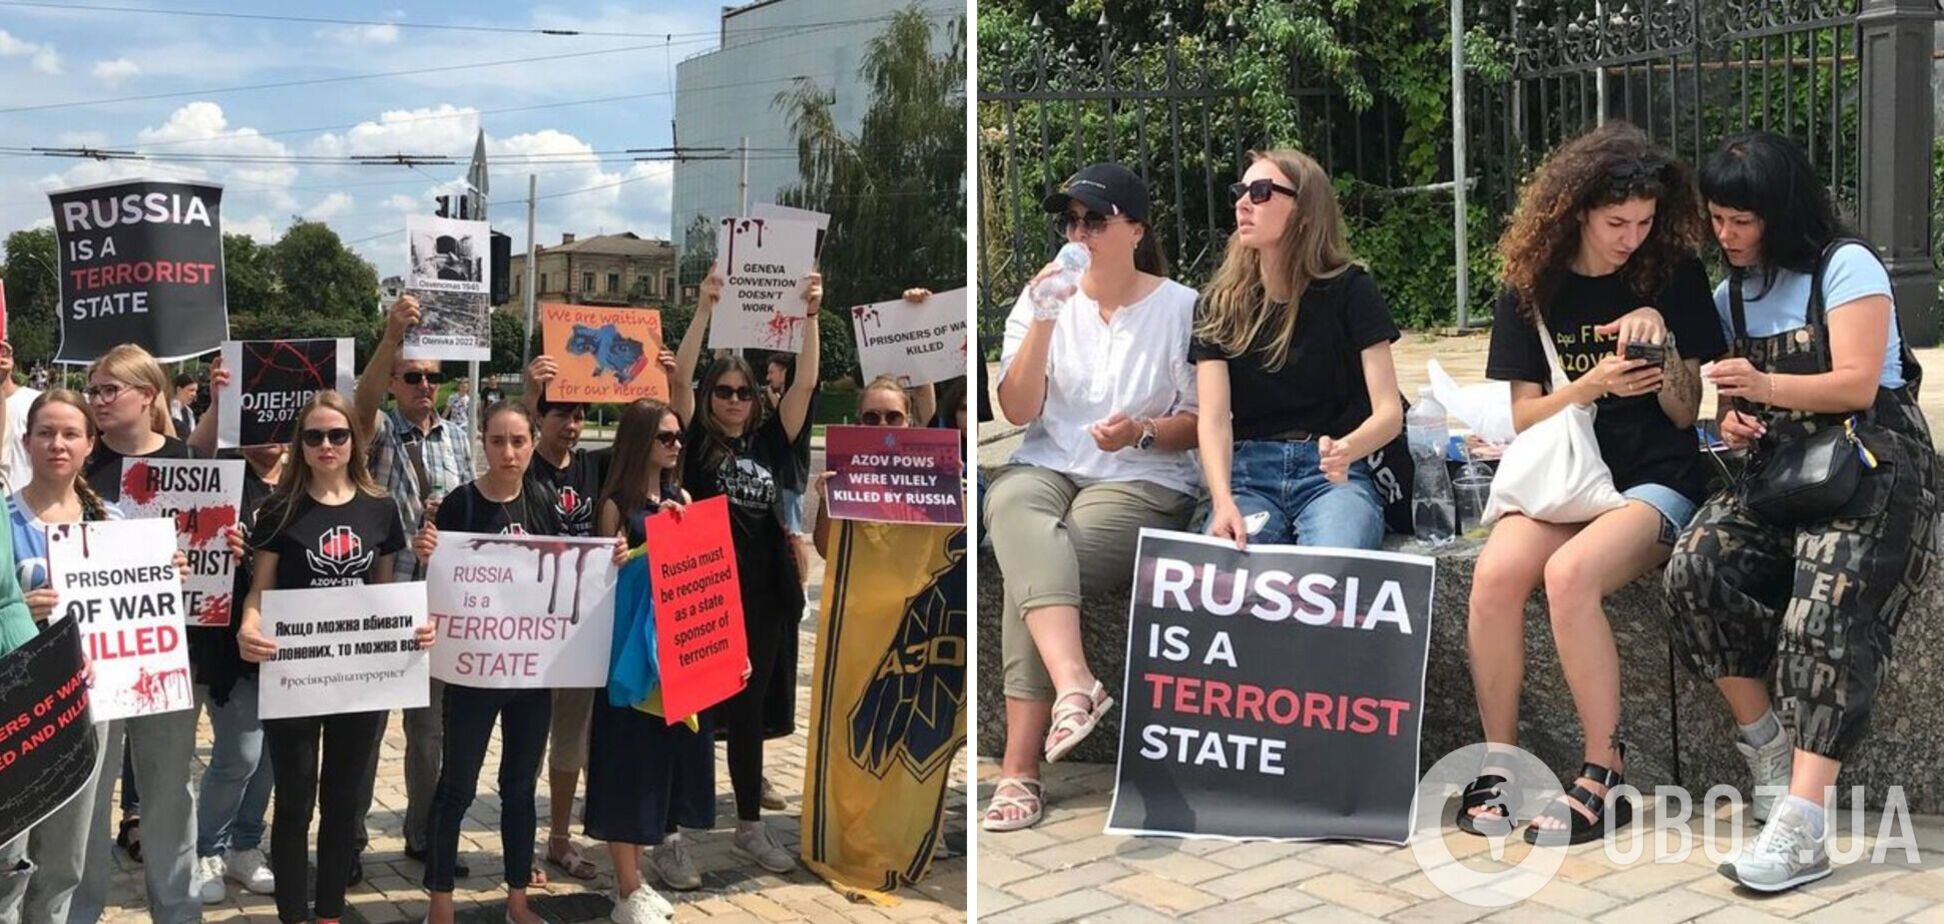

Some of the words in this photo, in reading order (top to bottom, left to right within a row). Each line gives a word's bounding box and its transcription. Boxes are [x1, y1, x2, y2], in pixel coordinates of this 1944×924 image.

[63, 192, 212, 232] RUSSIA
[70, 240, 93, 261] IS
[101, 237, 116, 257] A
[70, 261, 215, 290] TERRORIST
[743, 263, 785, 274] GENEVA
[729, 276, 796, 287] CONVENTION
[73, 292, 148, 320] STATE
[738, 290, 784, 299] DOESN'T
[547, 309, 571, 321] We
[575, 312, 598, 323] are
[601, 310, 658, 328] waiting
[742, 303, 775, 312] WORK
[869, 329, 931, 347] PRISONERS
[933, 325, 948, 337] OF
[906, 341, 944, 355] KILLED
[557, 379, 579, 399] for
[584, 384, 609, 394] our
[612, 382, 658, 396] heroes
[851, 454, 890, 466] AZOV
[893, 456, 935, 468] POWS
[145, 466, 221, 493] RUSSIA
[849, 473, 887, 485] WERE
[891, 474, 938, 487] VILELY
[833, 490, 881, 503] KILLED
[884, 492, 902, 503] BY
[906, 494, 957, 506] RUSSIA
[453, 566, 513, 583] RUSSIA
[661, 554, 697, 579] Russia
[698, 546, 724, 568] must
[65, 564, 175, 589] PRISONERS
[660, 587, 675, 604] be
[676, 566, 732, 597] recognized
[66, 600, 101, 624] OF
[110, 592, 176, 621] WAR
[463, 592, 477, 608] is
[481, 595, 490, 608] a
[674, 607, 688, 622] as
[689, 605, 697, 618] a
[698, 593, 724, 614] state
[1151, 557, 1413, 634] RUSSIA
[275, 621, 313, 637] Якщо
[316, 618, 360, 634] можна
[363, 615, 413, 631] вбивати
[430, 613, 572, 640] TERRORIST
[674, 620, 717, 646] sponsor
[718, 611, 729, 628] of
[87, 625, 179, 660] ILLED
[266, 644, 335, 661] олонених,
[338, 643, 352, 656] то
[355, 639, 398, 655] можна
[679, 640, 729, 667] terrorism
[1149, 623, 1190, 662] IS
[1203, 631, 1238, 668] A
[456, 651, 539, 676] STATE
[33, 694, 55, 718] OF
[1144, 673, 1410, 736] TERRORIST
[21, 724, 56, 756] AND
[1140, 724, 1287, 775] STATE
